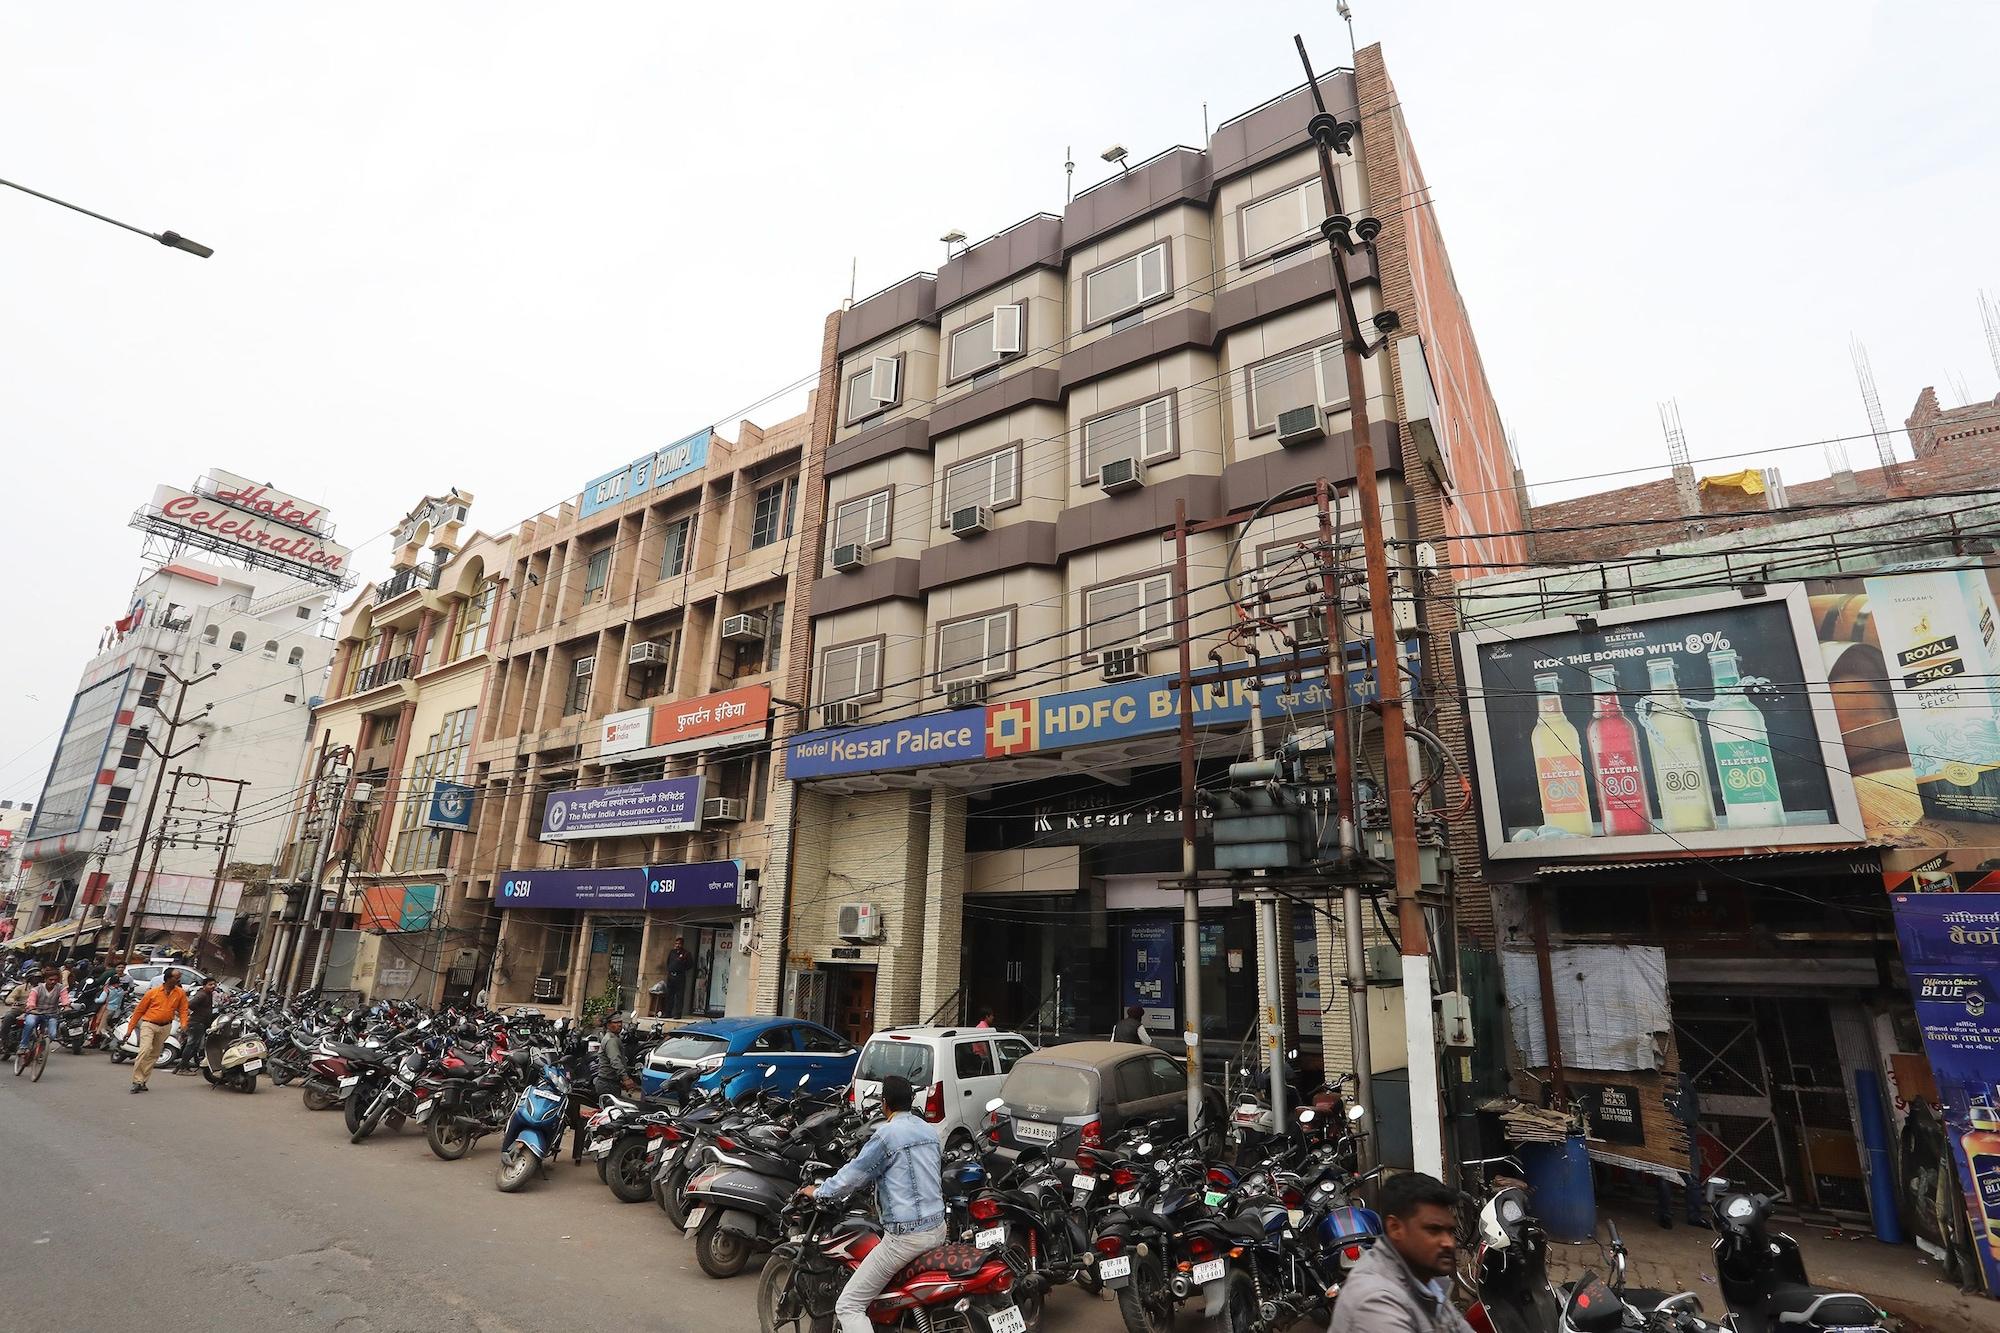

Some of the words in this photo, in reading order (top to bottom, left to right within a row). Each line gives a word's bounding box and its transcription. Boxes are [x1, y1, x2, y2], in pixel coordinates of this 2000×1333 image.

[217, 485, 322, 529] Hotel
[162, 496, 344, 571] Celebration
[1604, 631, 1645, 643] ELECTRA
[1533, 657, 1564, 670] KICK
[1566, 653, 1592, 665] THE
[1594, 647, 1645, 662] BORING
[1646, 641, 1683, 655] WITH
[1685, 631, 1730, 654] 8%
[1905, 641, 1951, 662] ROYAL
[1916, 665, 1953, 683] STAG
[1045, 695, 1136, 734] HDFC
[1149, 679, 1253, 719] BANK
[1921, 692, 1960, 709] SELECT
[677, 706, 711, 732] फुलर्टन
[715, 701, 746, 722] इंडिया
[617, 722, 640, 731] Fullerton
[796, 741, 828, 759] Hotel
[831, 737, 890, 762] Kesar
[897, 728, 971, 753] Palace
[1720, 756, 1769, 766] ELECTRA
[1599, 766, 1639, 775] ELECTRA
[598, 809, 615, 818] India
[617, 807, 655, 817] Assurance
[514, 880, 531, 897] SBI
[660, 880, 675, 892] SBI
[1953, 978, 1978, 986] Choice
[1920, 986, 1964, 997] BLUE
[997, 1312, 1014, 1325] UP78
